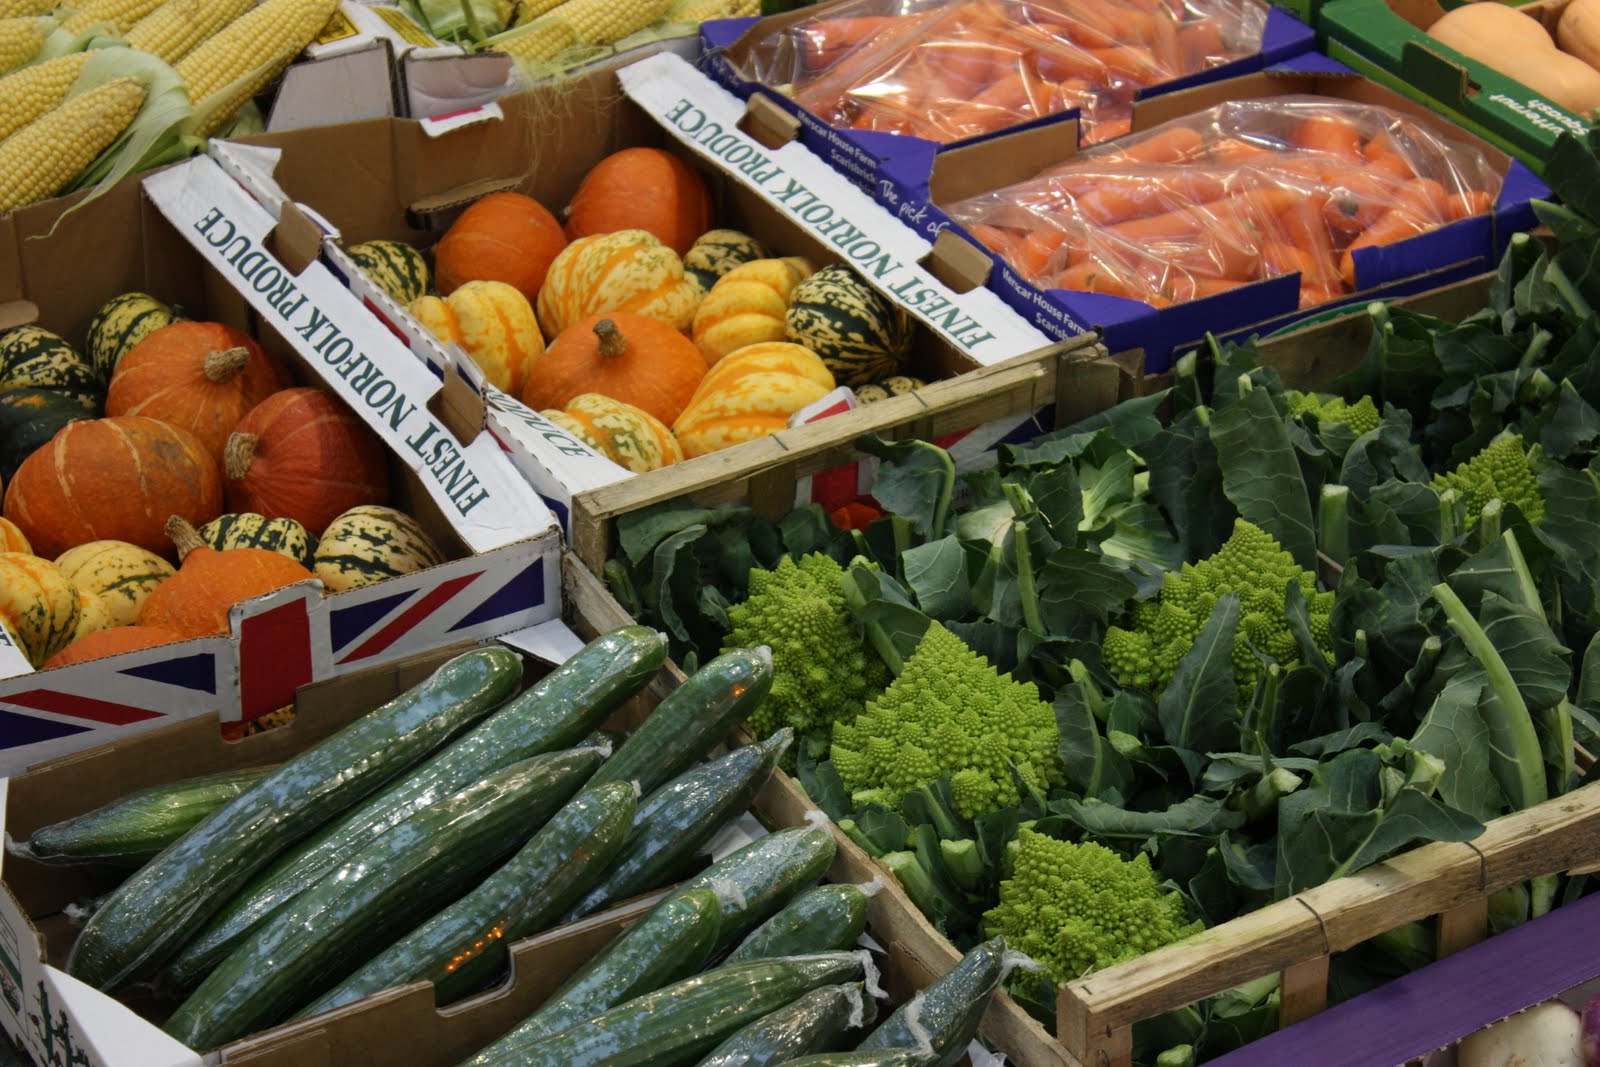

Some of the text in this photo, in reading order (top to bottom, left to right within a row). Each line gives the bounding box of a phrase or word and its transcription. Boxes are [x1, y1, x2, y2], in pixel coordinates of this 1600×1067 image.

[1489, 94, 1566, 138] utternut
[827, 130, 856, 156] House
[854, 147, 878, 169] Farm
[830, 148, 877, 184] Scarisbrick
[665, 98, 998, 350] FINEST NORFOLK PRODUCE
[880, 179, 898, 205] The
[898, 200, 927, 225] pick
[926, 221, 950, 238] of
[1032, 292, 1064, 321] House
[1035, 312, 1069, 340] Scarisb
[193, 206, 491, 518] FINEST NORFOLK PRODUCE
[488, 389, 595, 458] ODUCE
